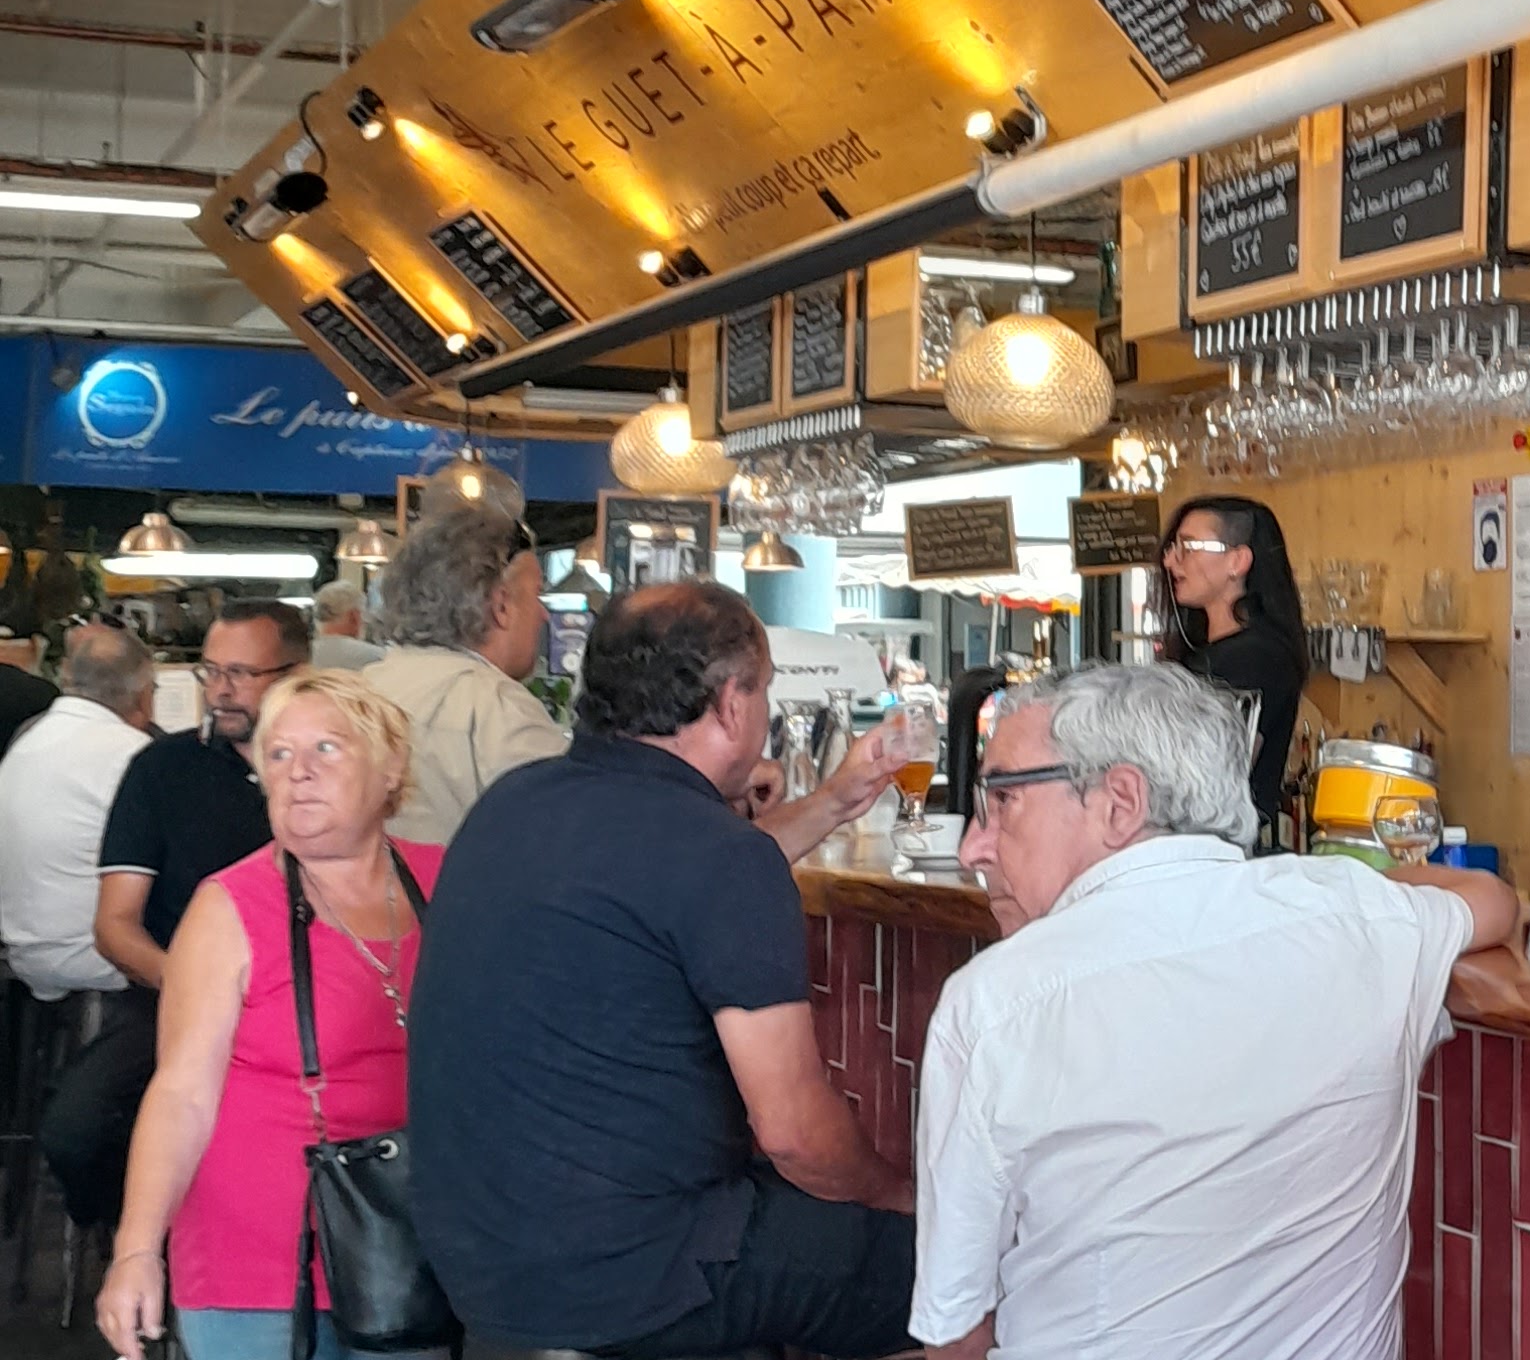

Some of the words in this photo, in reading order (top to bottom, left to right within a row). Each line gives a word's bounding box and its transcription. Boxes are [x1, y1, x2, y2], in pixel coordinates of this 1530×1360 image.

[526, 119, 595, 182] LE
[734, 172, 789, 210] coup
[772, 158, 805, 194] et
